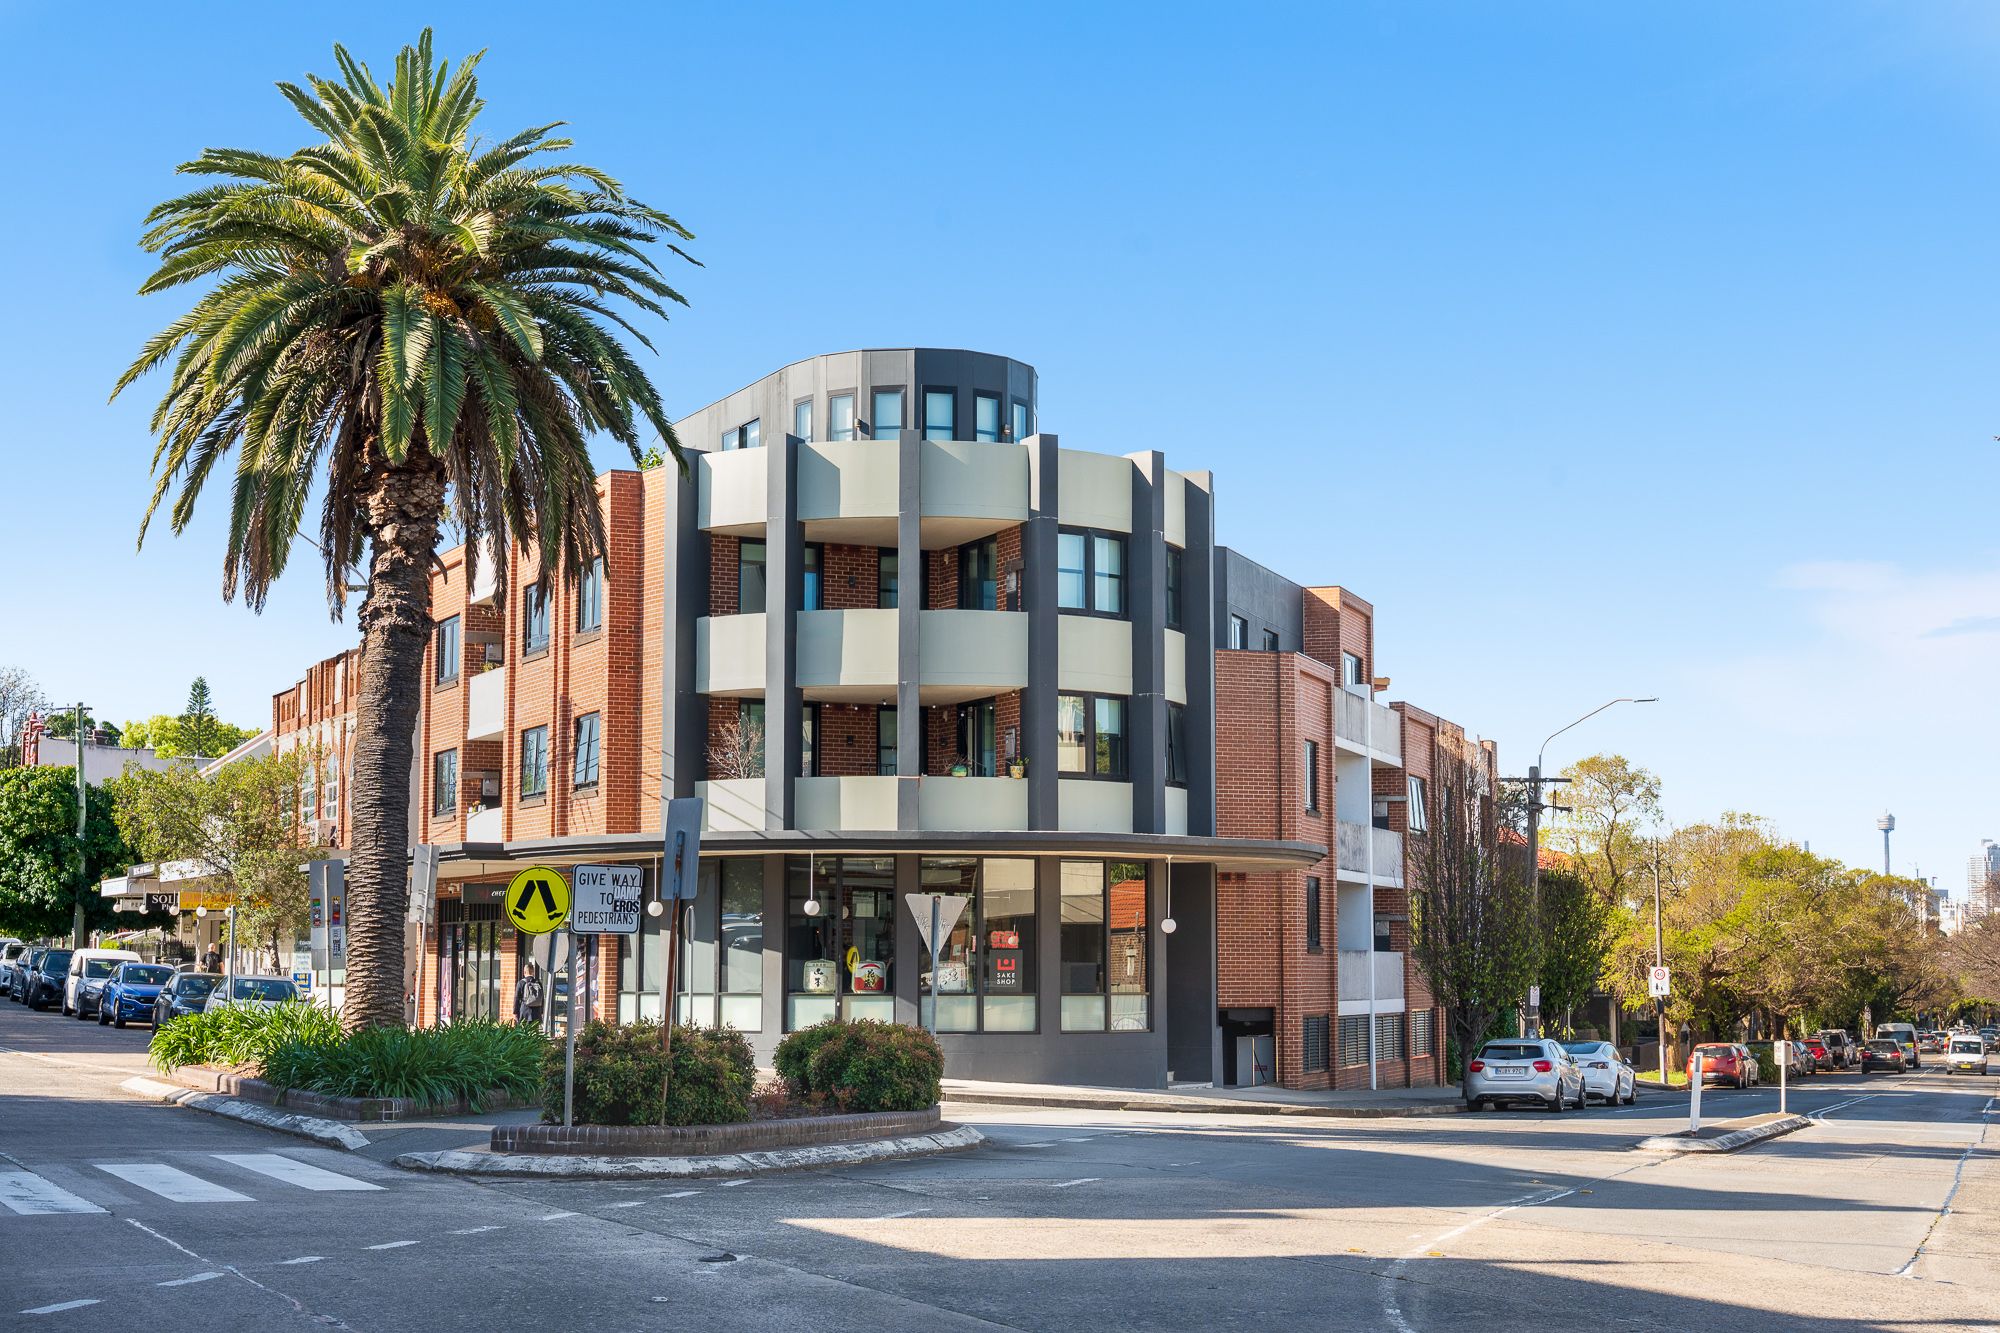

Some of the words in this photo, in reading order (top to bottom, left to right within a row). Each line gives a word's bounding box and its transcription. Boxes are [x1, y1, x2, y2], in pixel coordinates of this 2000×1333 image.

[579, 873, 606, 886] GIVE
[612, 874, 637, 887] WAY
[600, 892, 614, 905] TO
[614, 887, 641, 900] DAMP
[614, 900, 640, 913] EROS
[578, 911, 634, 925] PEDESTRIANS
